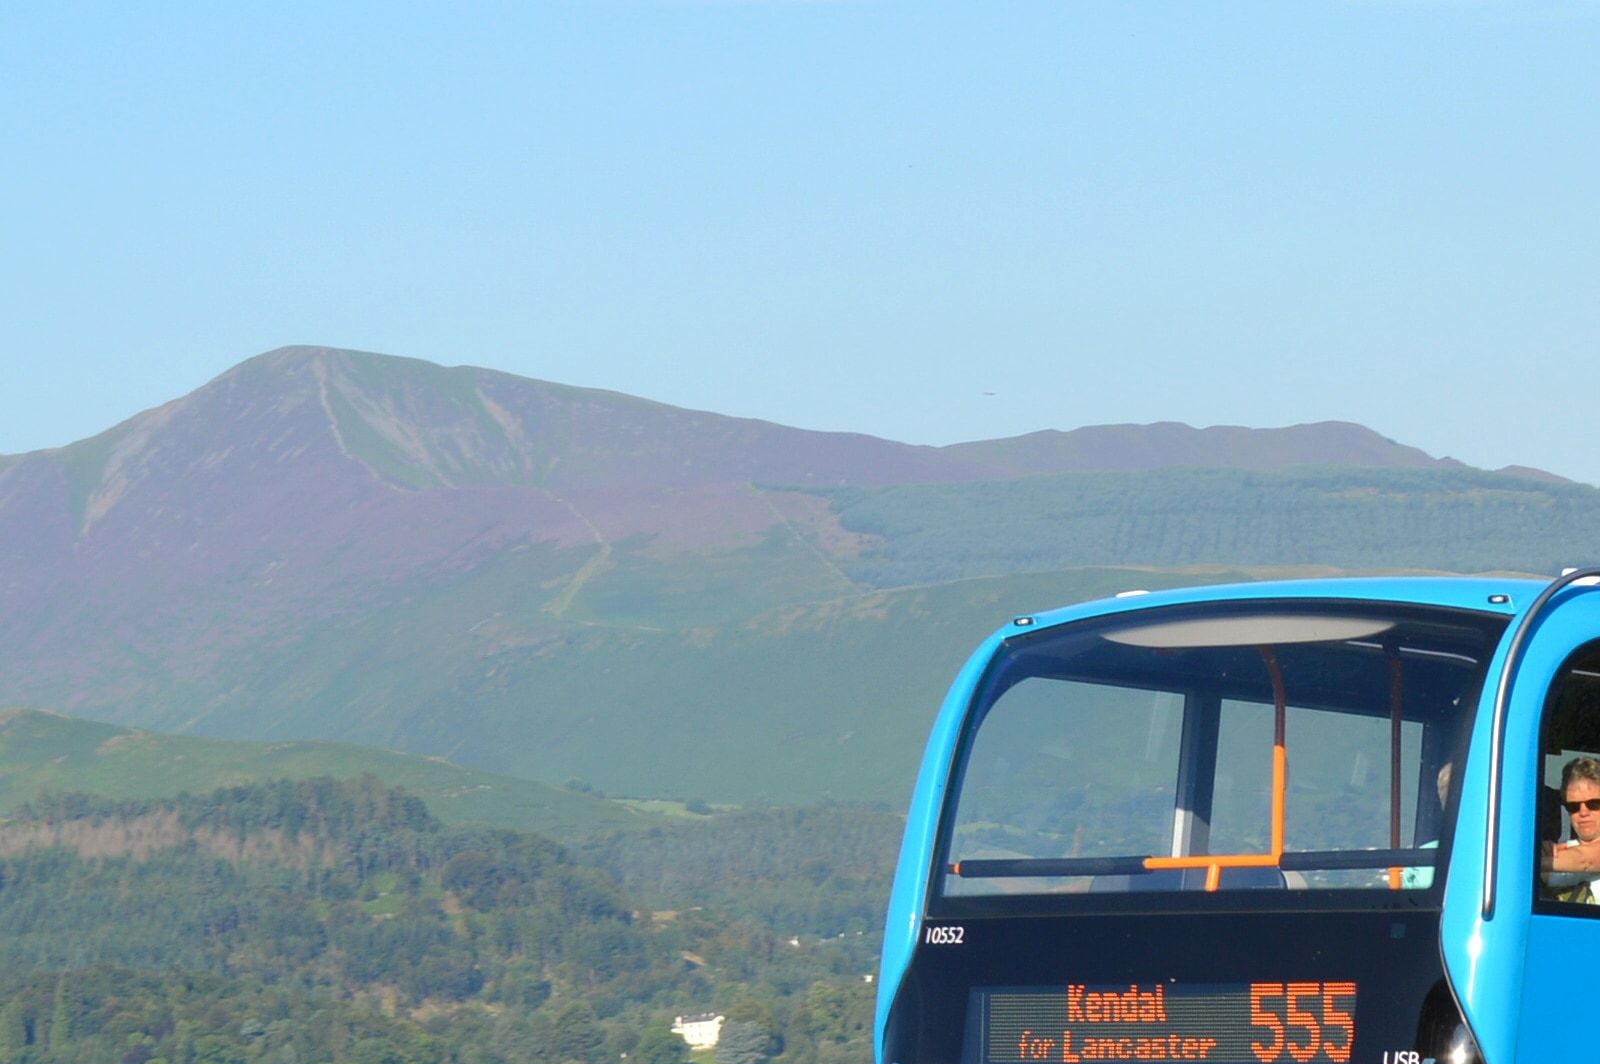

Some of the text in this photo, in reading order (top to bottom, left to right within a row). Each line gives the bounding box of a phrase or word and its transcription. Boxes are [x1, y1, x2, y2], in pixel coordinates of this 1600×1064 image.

[925, 926, 965, 944] 10552
[1067, 984, 1167, 1022] Kendal
[1250, 982, 1356, 1063] 555
[1018, 1030, 1217, 1063] for Lancaster
